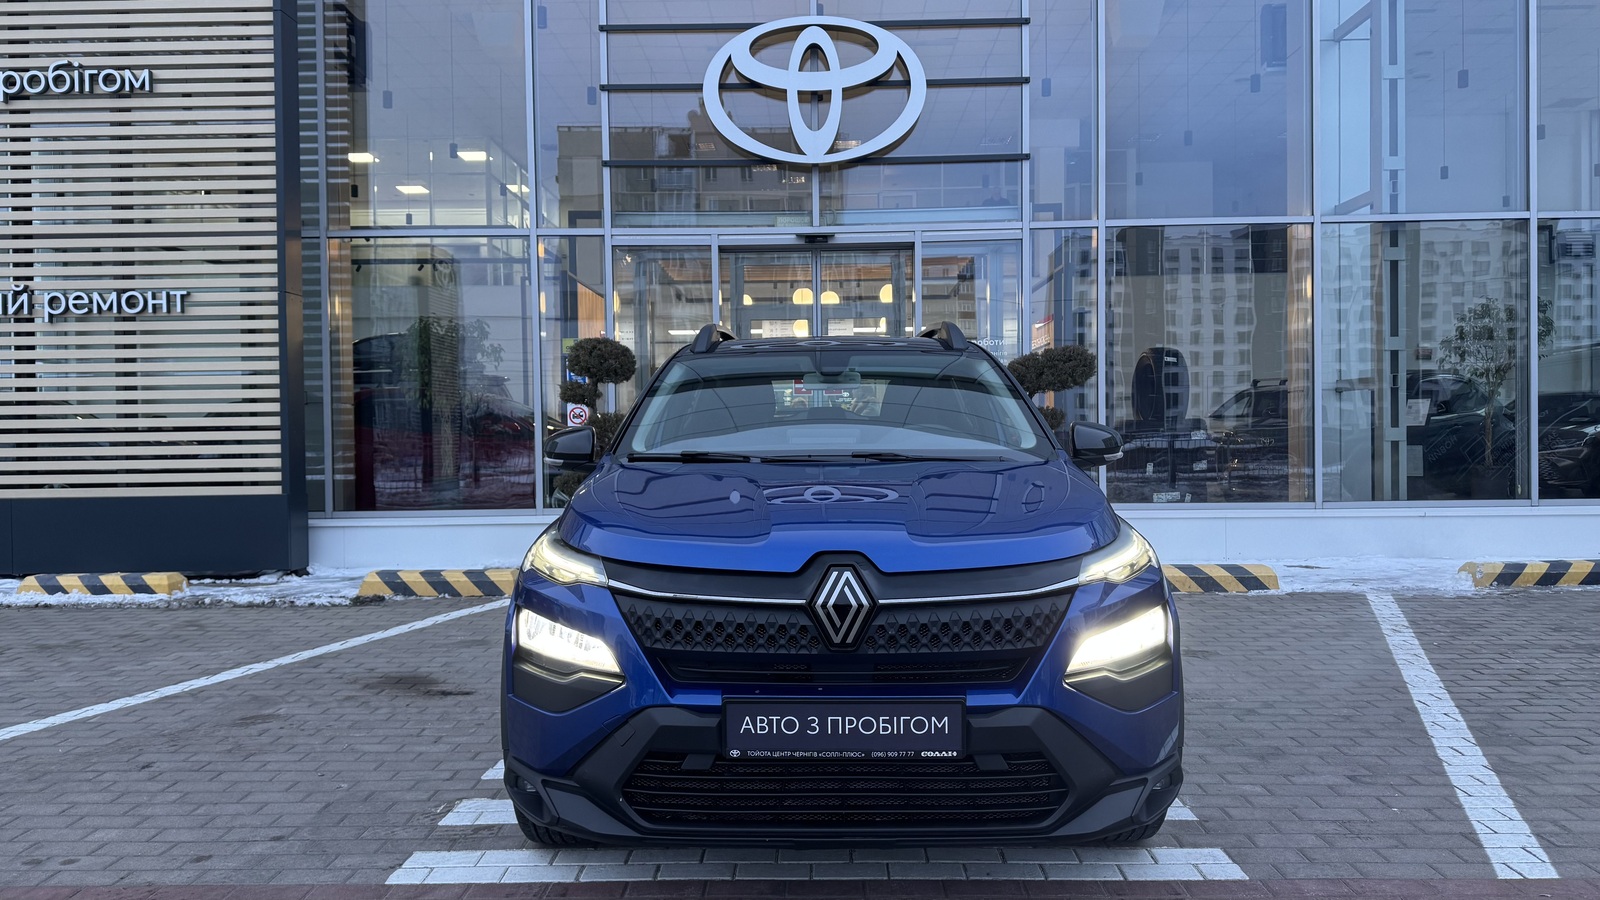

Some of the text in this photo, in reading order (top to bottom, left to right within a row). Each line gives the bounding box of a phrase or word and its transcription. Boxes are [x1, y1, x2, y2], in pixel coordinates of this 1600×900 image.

[0, 283, 188, 323] й ремонт
[740, 716, 799, 735] АВТО
[827, 716, 949, 735] ПРОБІГОМ
[747, 749, 771, 757] ТОЙОТА
[772, 750, 791, 758] ЦЕНТР
